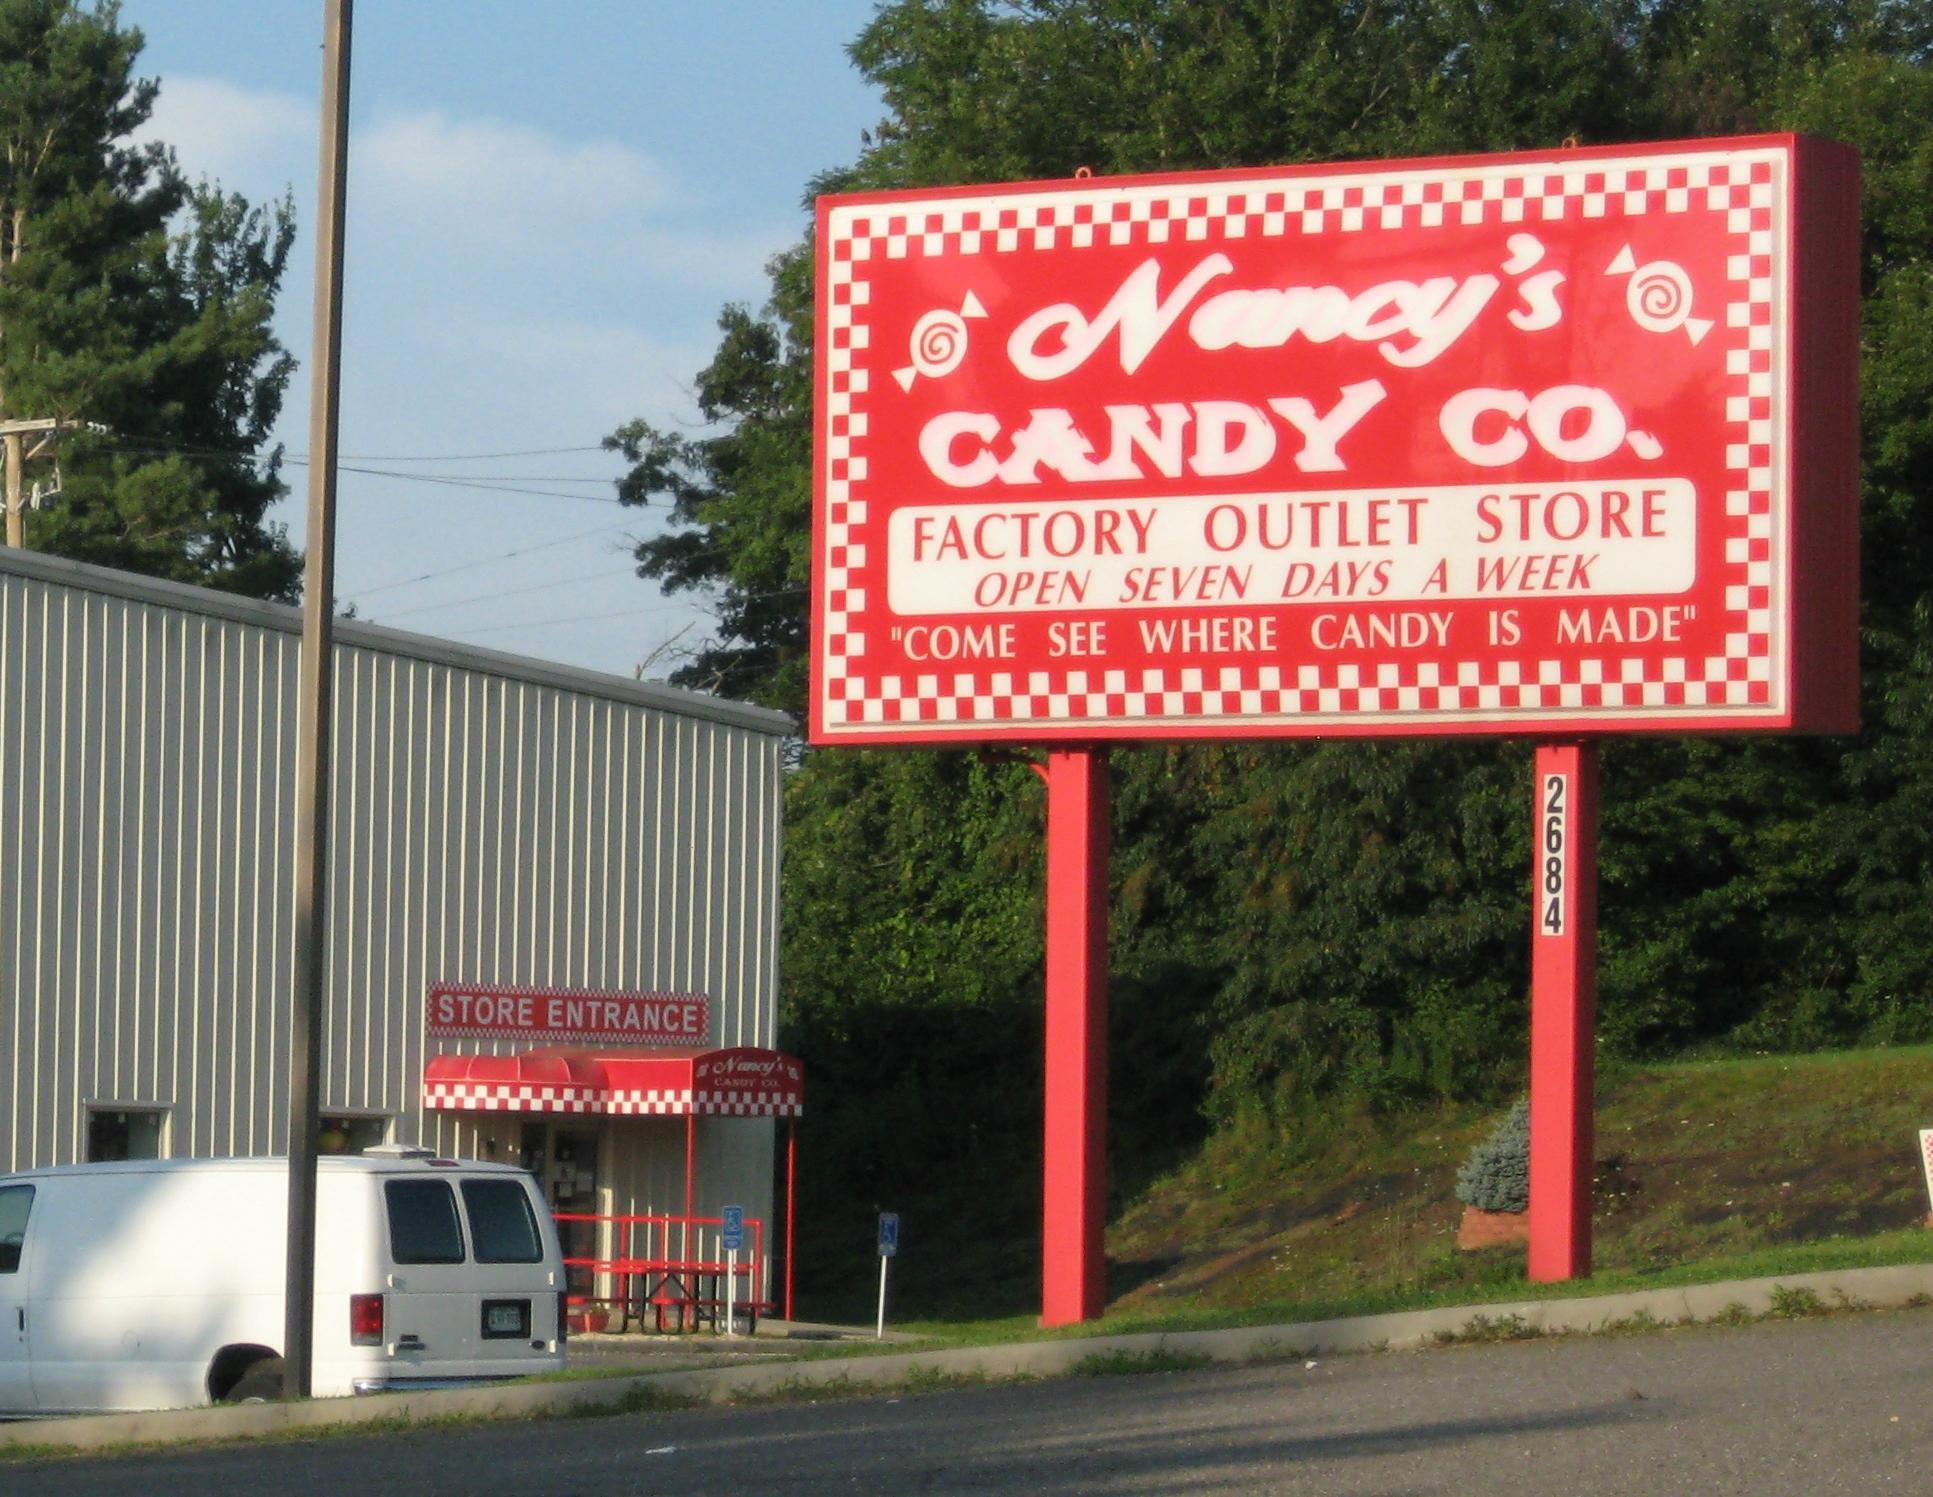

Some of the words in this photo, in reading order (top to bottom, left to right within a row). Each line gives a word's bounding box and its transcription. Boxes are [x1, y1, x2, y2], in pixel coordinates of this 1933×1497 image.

[1007, 233, 1566, 381] Nancy's
[919, 379, 1387, 487] CANDY
[1440, 385, 1664, 466] CO.
[913, 509, 1158, 562] FACTORY
[1203, 498, 1429, 552] OUTLET
[1476, 489, 1667, 544] STORE
[974, 568, 1092, 608] OPEN
[1119, 564, 1253, 603] SEVEN
[1281, 560, 1394, 598] DAYS
[1422, 557, 1449, 594] A
[1475, 553, 1600, 592] WEEK
[891, 624, 1017, 661] "COME
[1048, 620, 1107, 657] SEE
[1138, 616, 1278, 654] WHERE
[1310, 611, 1454, 650] CANDY
[1488, 609, 1521, 646] IS
[1556, 605, 1696, 645] MADE"
[1544, 776, 1564, 934] 2684
[438, 994, 534, 1027] STORE
[547, 999, 698, 1033] ENTRANCE
